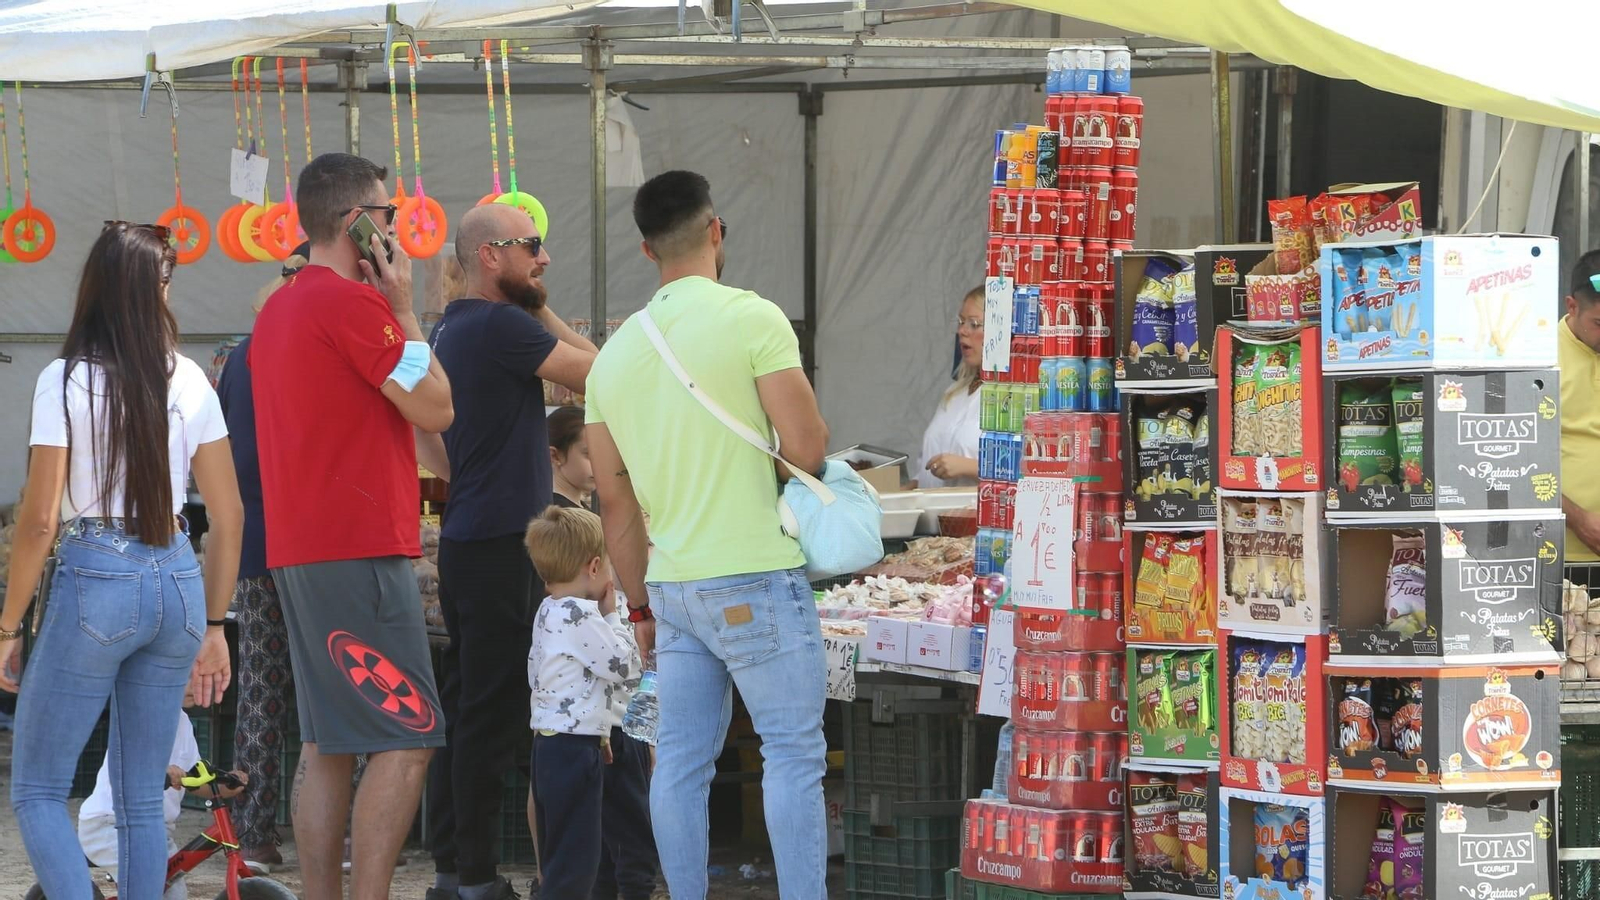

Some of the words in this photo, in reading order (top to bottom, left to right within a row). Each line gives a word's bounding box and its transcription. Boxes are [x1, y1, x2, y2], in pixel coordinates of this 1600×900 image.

[1466, 264, 1532, 295] APETINAS
[985, 331, 1003, 360] FRIO
[1359, 336, 1391, 359] APETINAS
[1462, 420, 1530, 438] TOTAS
[1340, 444, 1386, 458] Campesinas
[1477, 461, 1519, 478] Patatas
[1485, 478, 1510, 491] Fritas
[1411, 496, 1432, 505] TOTAS
[1463, 565, 1528, 584] TOTAS
[1391, 580, 1425, 597] Fuet
[1482, 590, 1510, 598] GOURMET
[991, 612, 1012, 625] AGUA
[1478, 608, 1517, 624] Patatas
[1025, 627, 1062, 643] Cruzcampo
[1485, 624, 1510, 637] Fritas
[1022, 705, 1056, 721] Cruzcampo
[1267, 704, 1287, 722] BIG
[1470, 696, 1524, 718] CORNETES
[1477, 715, 1515, 745] WOW!
[1018, 786, 1050, 802] Cruzcampo
[1254, 820, 1307, 847] BOLAS
[1462, 839, 1527, 859] TOTAS
[977, 856, 1022, 880] Cruzcampo
